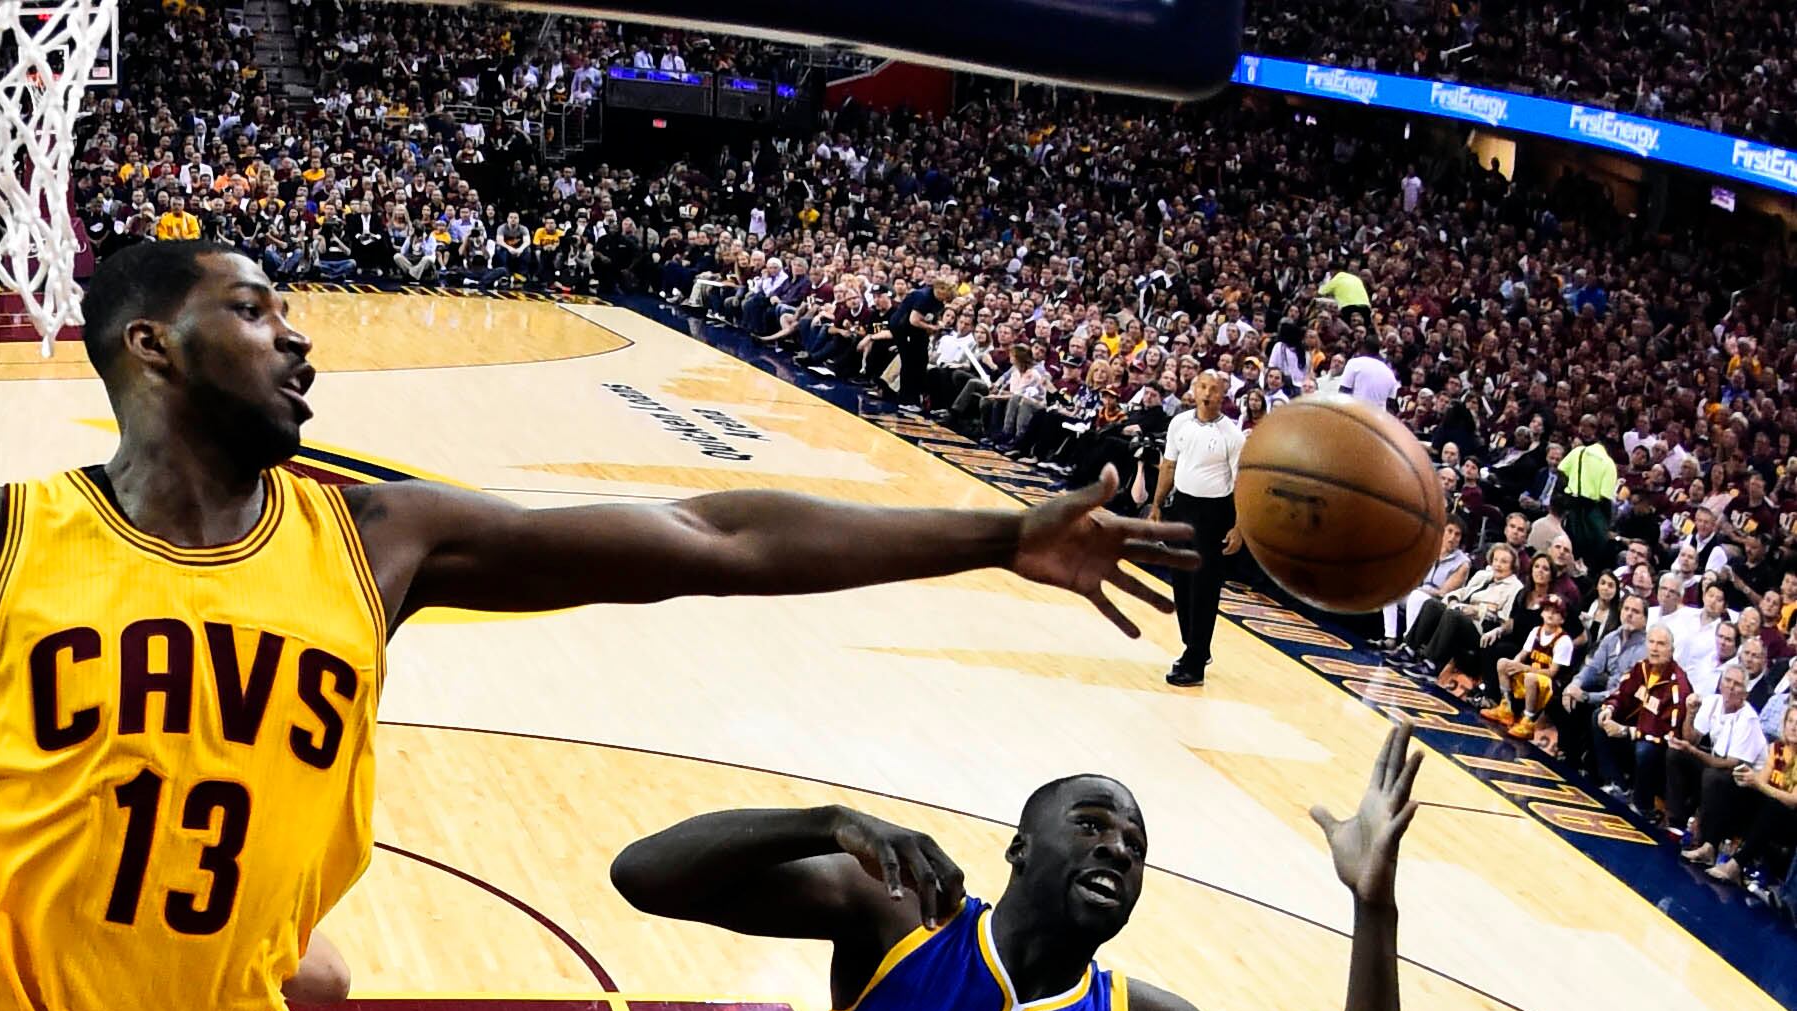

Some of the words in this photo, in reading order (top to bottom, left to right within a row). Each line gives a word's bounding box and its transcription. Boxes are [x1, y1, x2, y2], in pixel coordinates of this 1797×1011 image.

[1306, 64, 1378, 98] FirstEnergy
[1430, 81, 1507, 120] FirstEnergy
[1569, 104, 1661, 151] FirstEnergy
[1731, 138, 1797, 180] FirstEn
[29, 617, 359, 770] CAVS
[1451, 752, 1659, 846] ALL
[104, 767, 252, 936] 13
